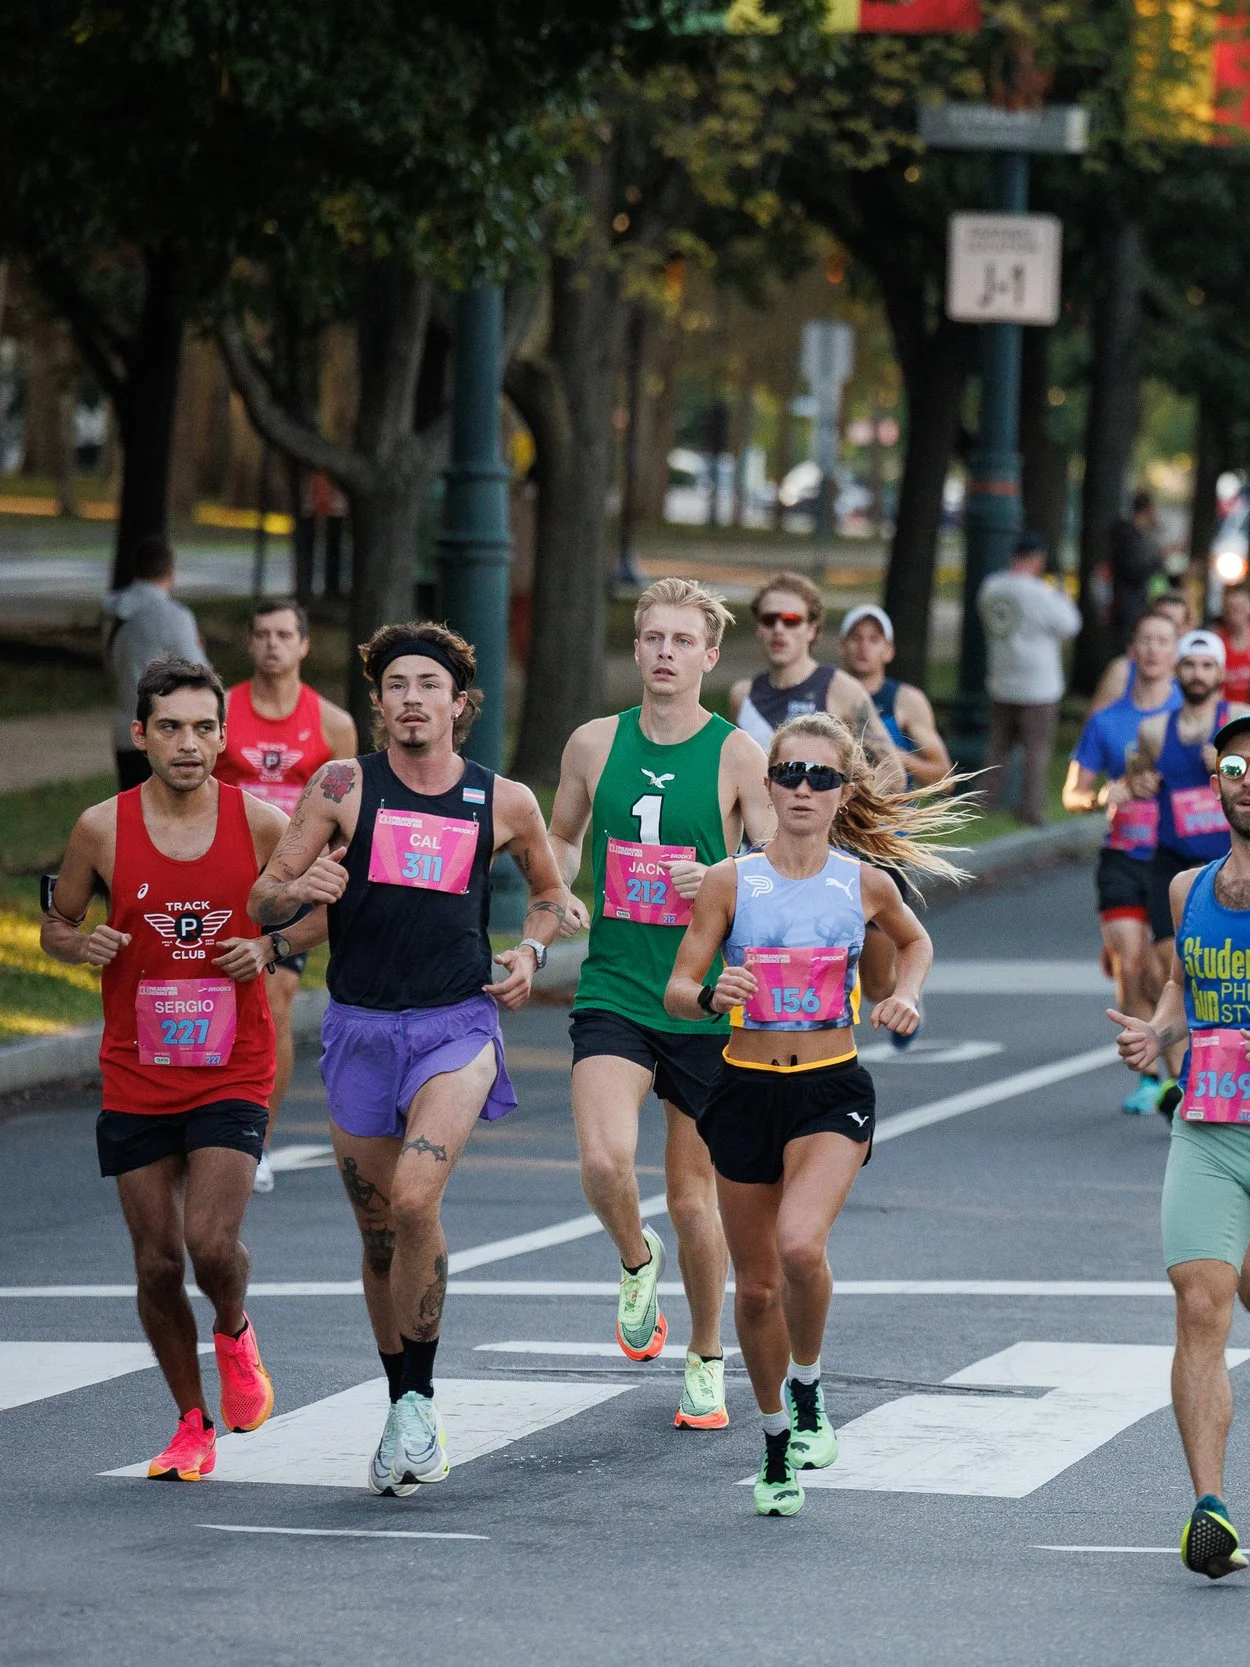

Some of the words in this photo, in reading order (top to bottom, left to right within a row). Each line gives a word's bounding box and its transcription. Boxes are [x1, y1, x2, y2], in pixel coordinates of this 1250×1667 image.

[630, 793, 664, 845] 1
[409, 833, 442, 850] CAL
[401, 852, 443, 882] 311
[626, 878, 667, 905] 212
[165, 901, 211, 911] TRACK
[181, 918, 198, 937] P
[663, 915, 676, 924] 212
[172, 950, 206, 960] CLUB
[154, 1000, 214, 1014] SERGIO
[771, 987, 821, 1014] 156
[161, 1019, 210, 1045] 227
[206, 1056, 221, 1064] 227
